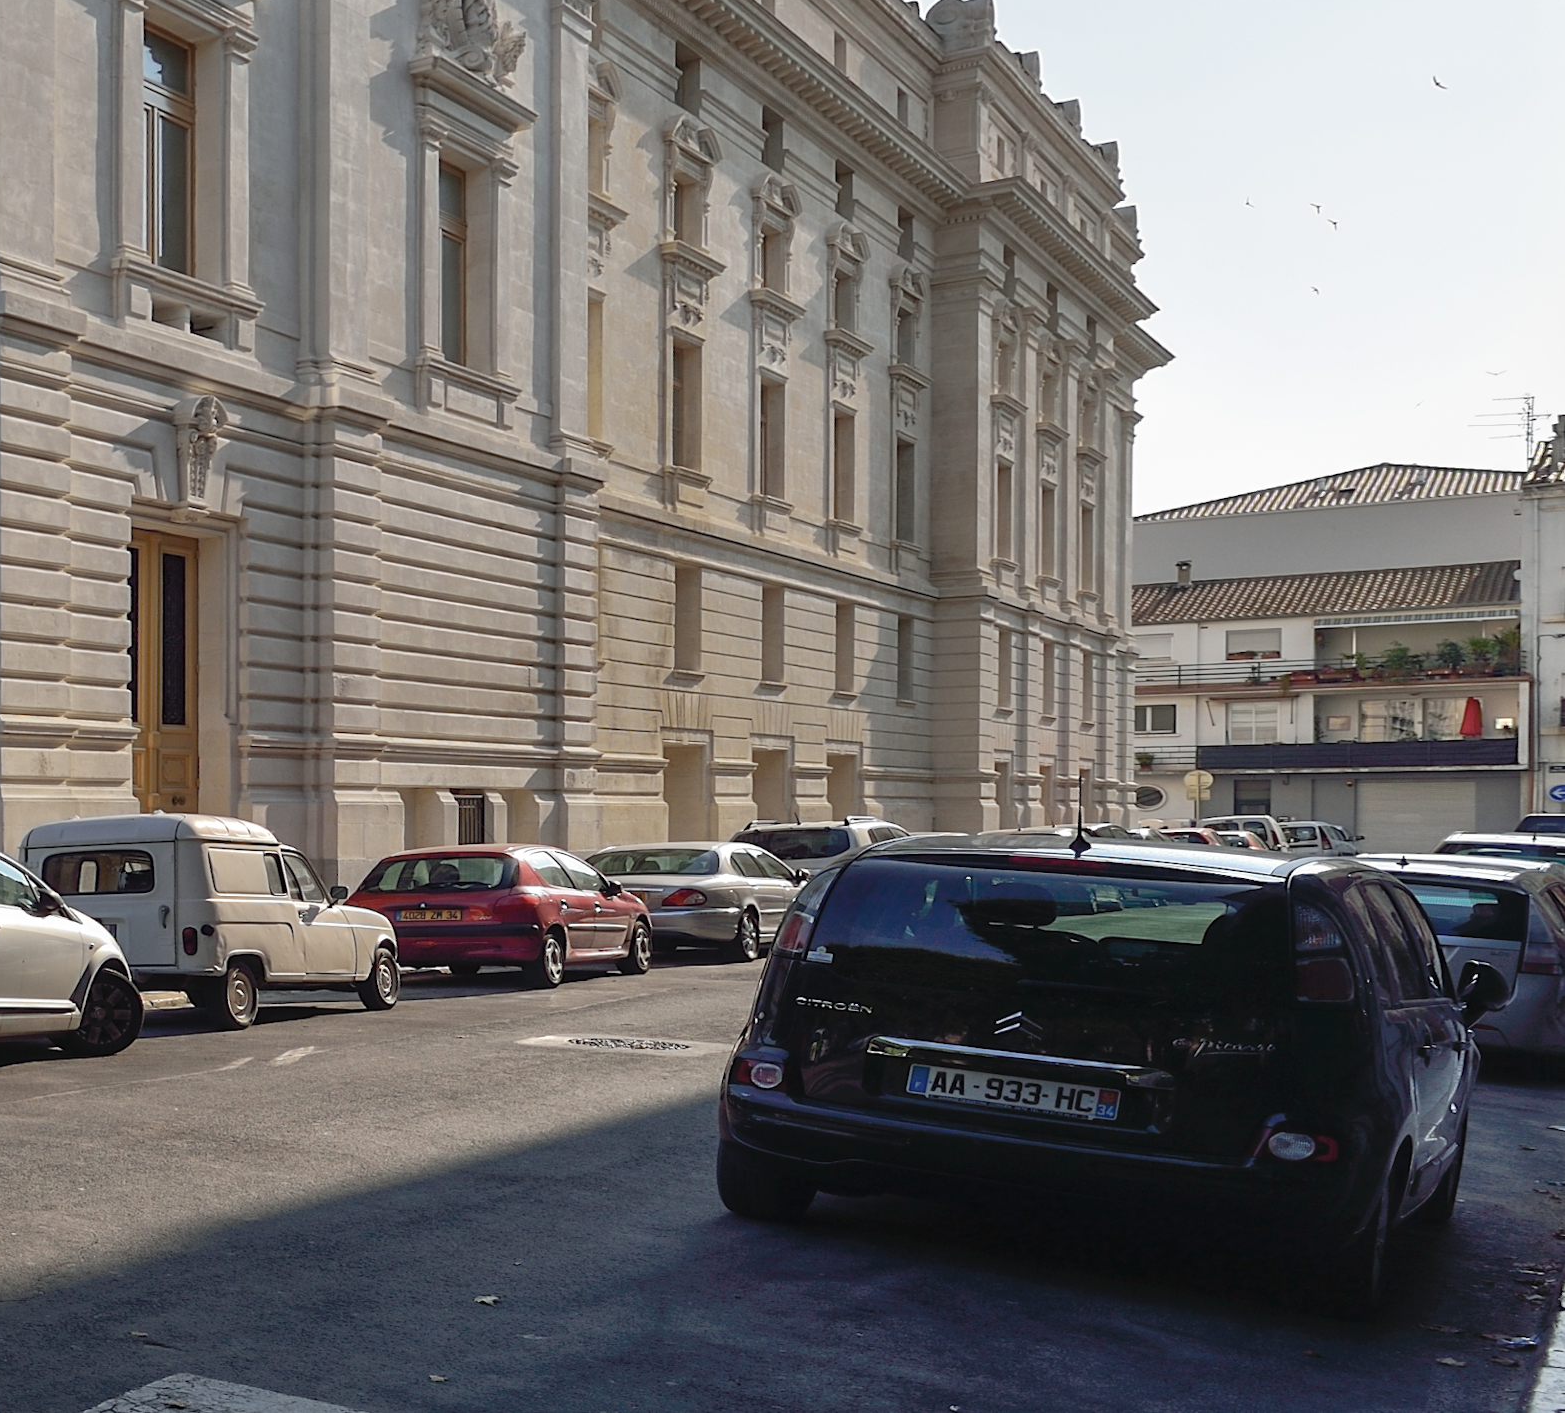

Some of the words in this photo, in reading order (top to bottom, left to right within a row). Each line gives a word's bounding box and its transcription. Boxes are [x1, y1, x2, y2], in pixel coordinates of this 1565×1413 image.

[402, 910, 426, 920] 4028
[446, 910, 458, 920] 34
[1097, 1104, 1114, 1117] 34
